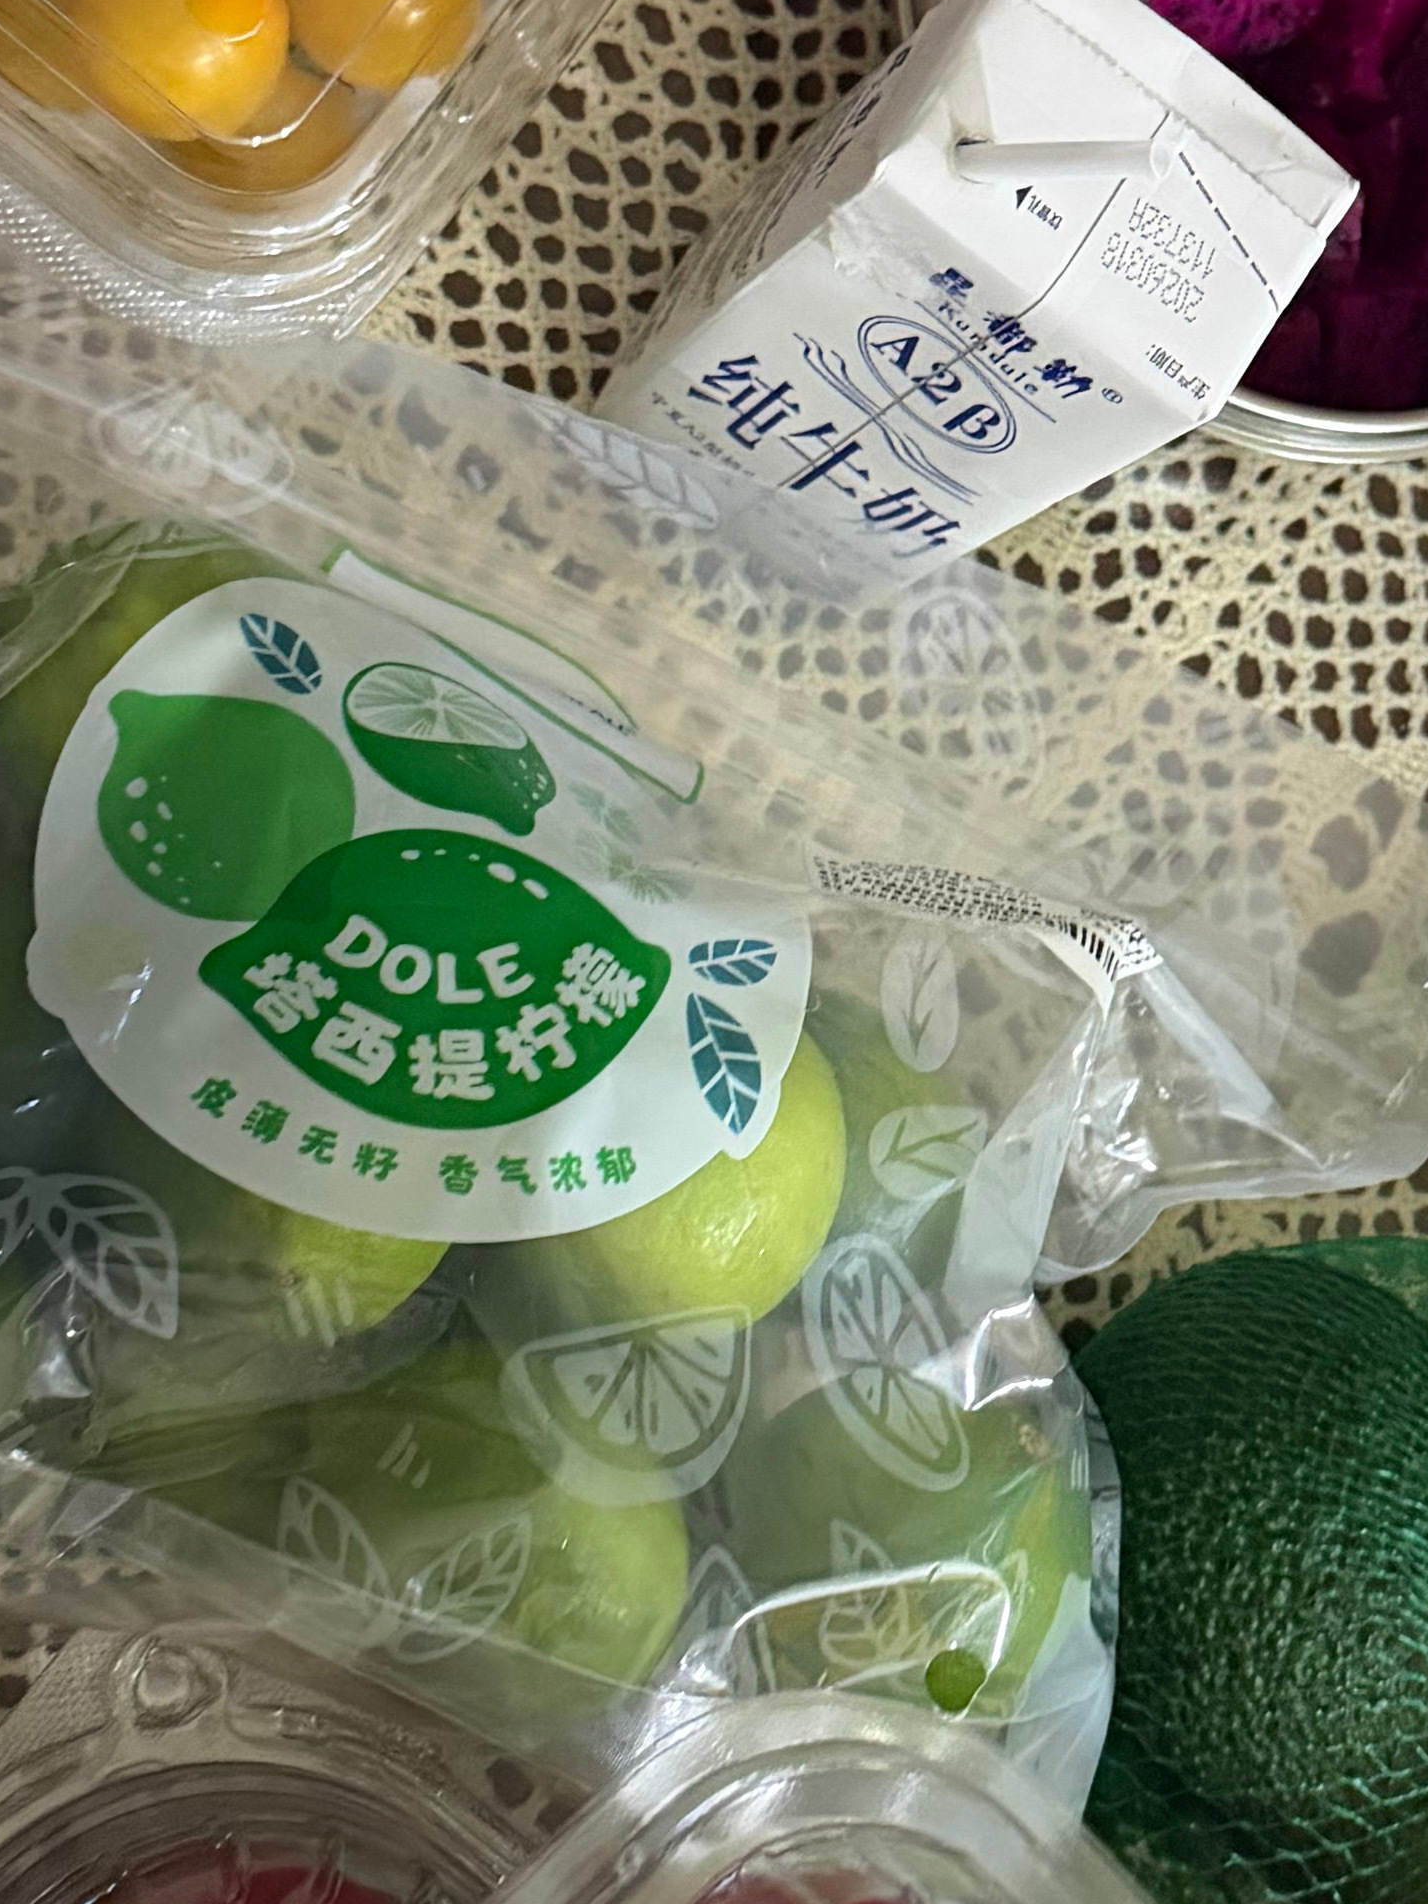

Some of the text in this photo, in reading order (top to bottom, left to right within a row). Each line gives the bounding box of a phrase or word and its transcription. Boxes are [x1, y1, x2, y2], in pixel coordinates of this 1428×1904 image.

[683, 351, 963, 564] 纯牛奶
[244, 942, 647, 1102] 塔西提柠檬
[323, 914, 535, 1005] DOLE
[190, 1077, 637, 1197] 皮薄无籽 香气浓郁
